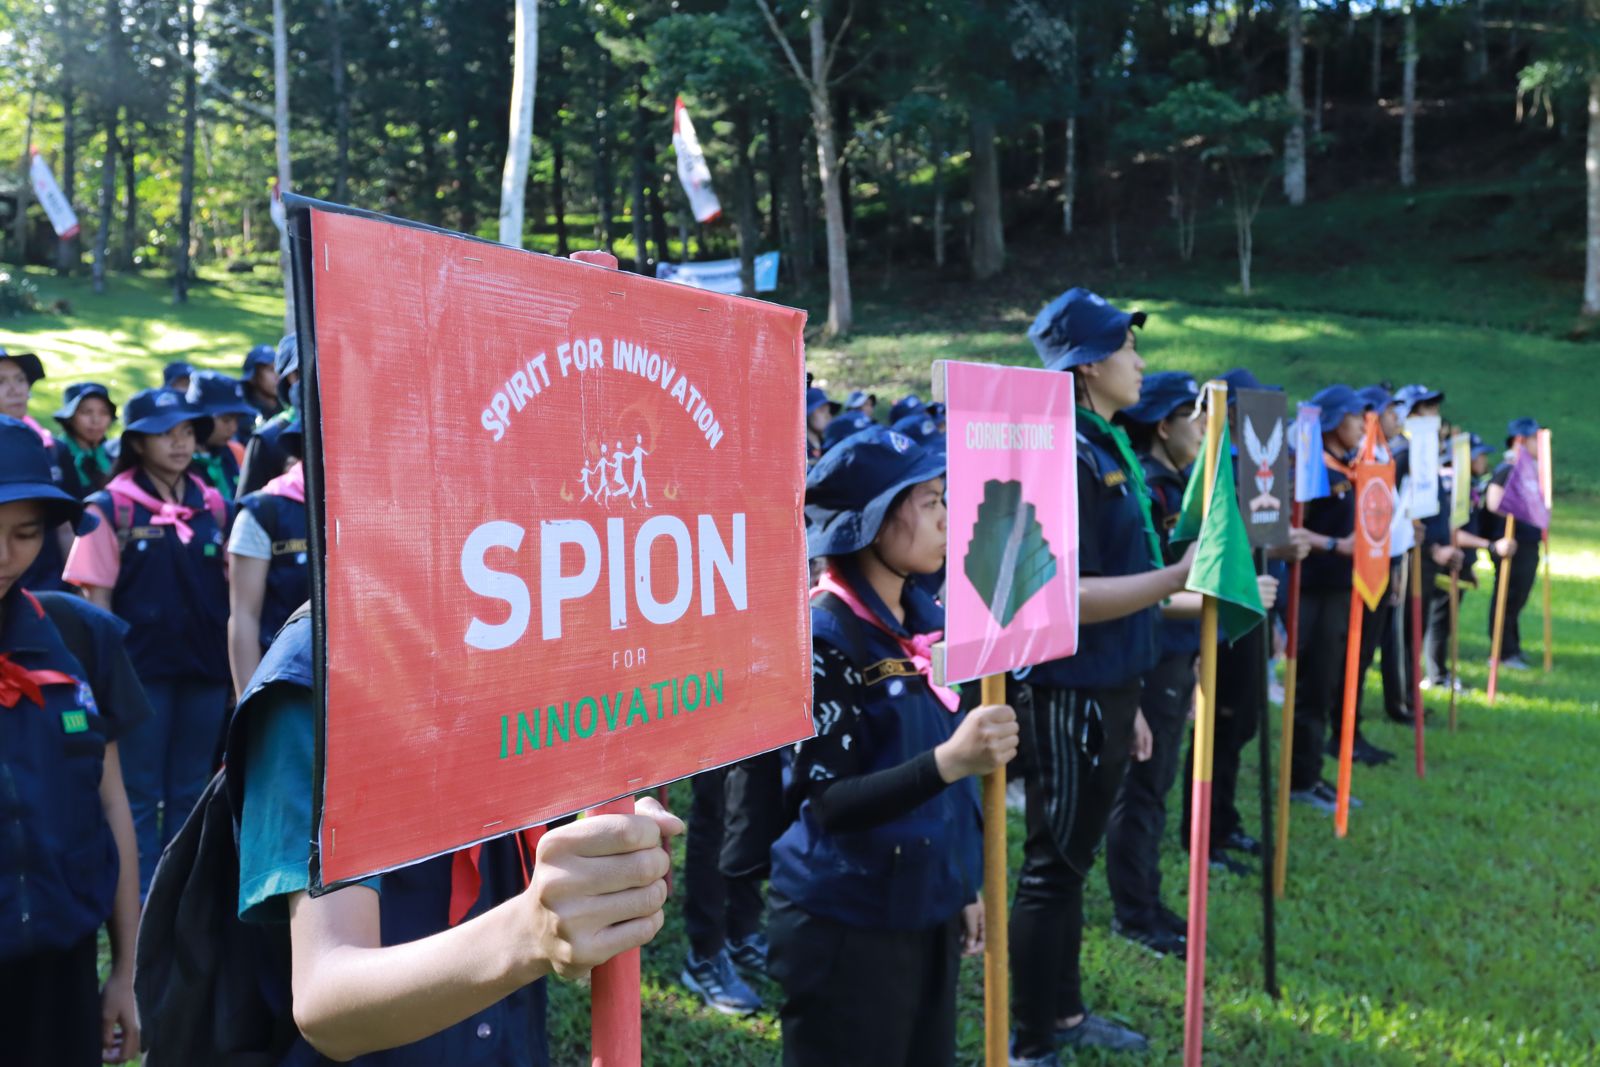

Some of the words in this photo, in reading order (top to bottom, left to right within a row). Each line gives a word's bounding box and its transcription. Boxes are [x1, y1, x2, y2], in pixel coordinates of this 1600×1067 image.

[481, 353, 550, 442] SPIRIT
[557, 338, 604, 378] FOR
[613, 339, 724, 449] INNOVATION
[966, 422, 1055, 450] CORNERSTONE
[460, 513, 748, 650] SPION
[612, 648, 647, 670] FOR
[500, 669, 724, 759] INNOVATION
